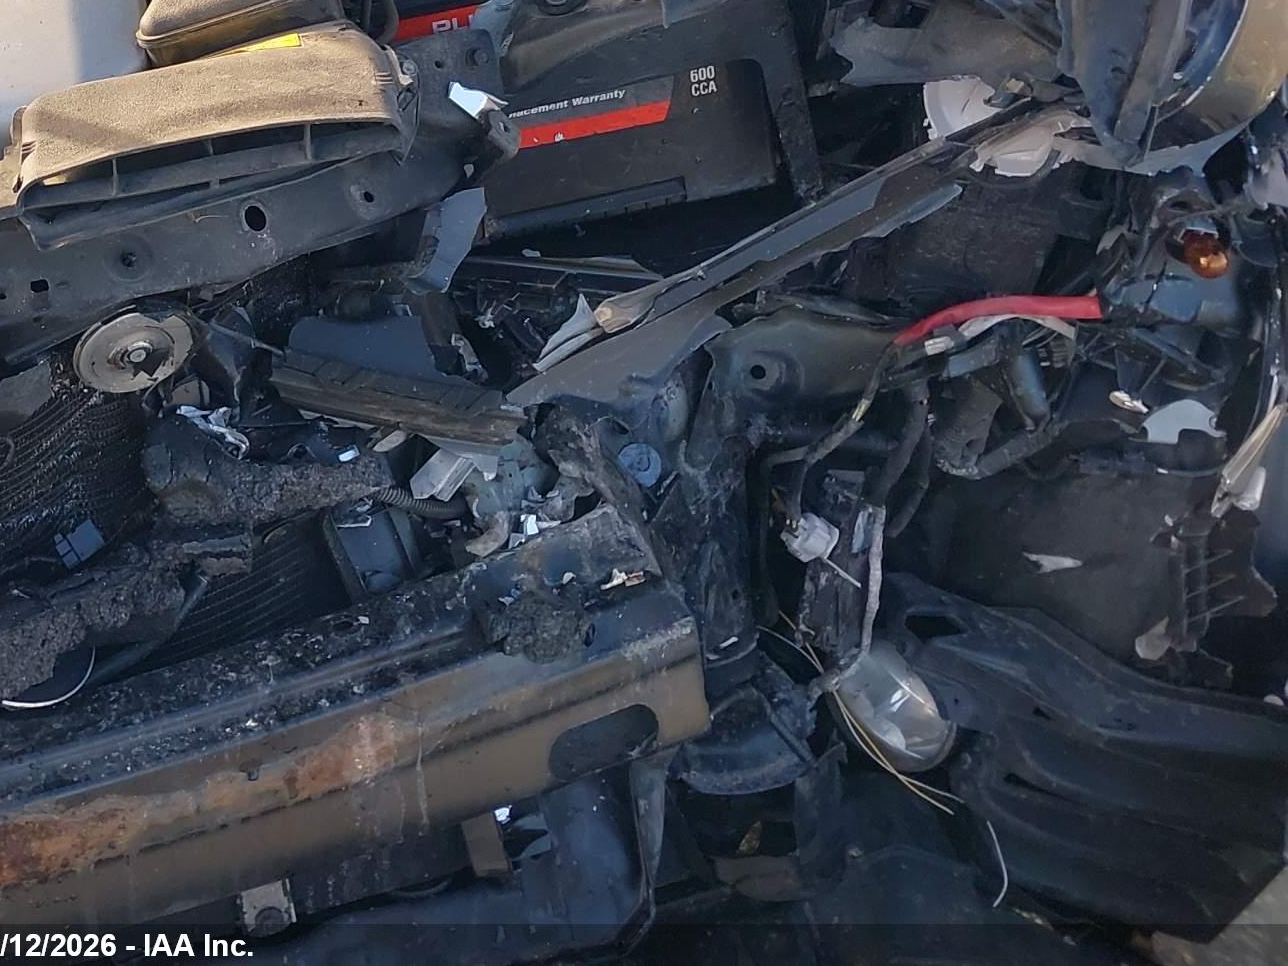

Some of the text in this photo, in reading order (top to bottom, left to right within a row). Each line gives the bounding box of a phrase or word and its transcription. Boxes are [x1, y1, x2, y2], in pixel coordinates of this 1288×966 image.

[689, 65, 715, 83] 600
[691, 80, 718, 97] CCA
[571, 89, 626, 107] Warranty
